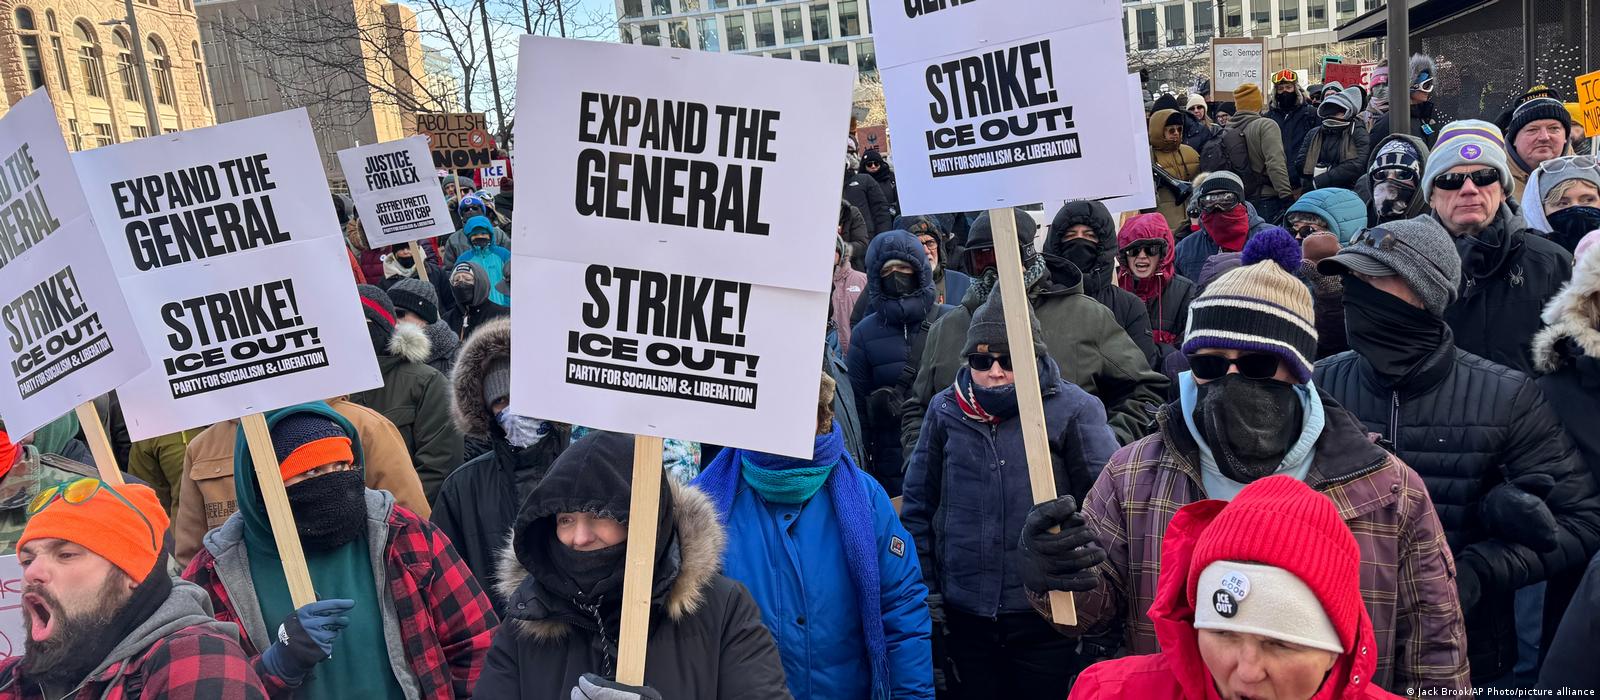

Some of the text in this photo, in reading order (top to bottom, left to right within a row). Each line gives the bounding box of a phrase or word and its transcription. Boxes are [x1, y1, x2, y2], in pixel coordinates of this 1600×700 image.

[1222, 48, 1233, 57] Sic
[925, 39, 1059, 124] STRIKE!
[417, 114, 486, 132] ABOLISH
[434, 132, 470, 149] ICE
[578, 91, 781, 162] EXPAND THE
[925, 105, 1075, 151] ICE OUT!
[4, 142, 40, 192] THE
[365, 150, 412, 174] JUSTICE
[431, 147, 490, 168] NOW
[484, 165, 503, 177] ICE
[932, 138, 1078, 174] PARTY FOR SOCIALISM & LIBERATION
[110, 153, 277, 219] EXPAND THE
[365, 166, 420, 191] FOR ALEX
[575, 148, 770, 236] GENERAL
[375, 194, 429, 214] JEFFREY PRETTI
[377, 206, 431, 226] KILLED BY CBP
[125, 194, 291, 271] GENERAL
[1, 264, 88, 353] STRIKE!
[160, 278, 304, 352] STRIKE!
[582, 263, 752, 348] STRIKE!
[11, 311, 103, 378] ICE OUT!
[163, 326, 321, 376] ICE OUT!
[567, 330, 760, 378] ICE OUT!
[20, 337, 111, 396] PARTY FOR SOCIALISM & LIBERATION
[173, 351, 325, 395] PARTY FOR SOCIALISM & LIBERATION
[568, 363, 753, 404] PARTY FOR SOCIALISM & LIBERATION
[1217, 593, 1230, 604] ICE
[1221, 579, 1245, 597] GOOD
[1230, 576, 1243, 587] BE
[1216, 602, 1232, 613] OUT
